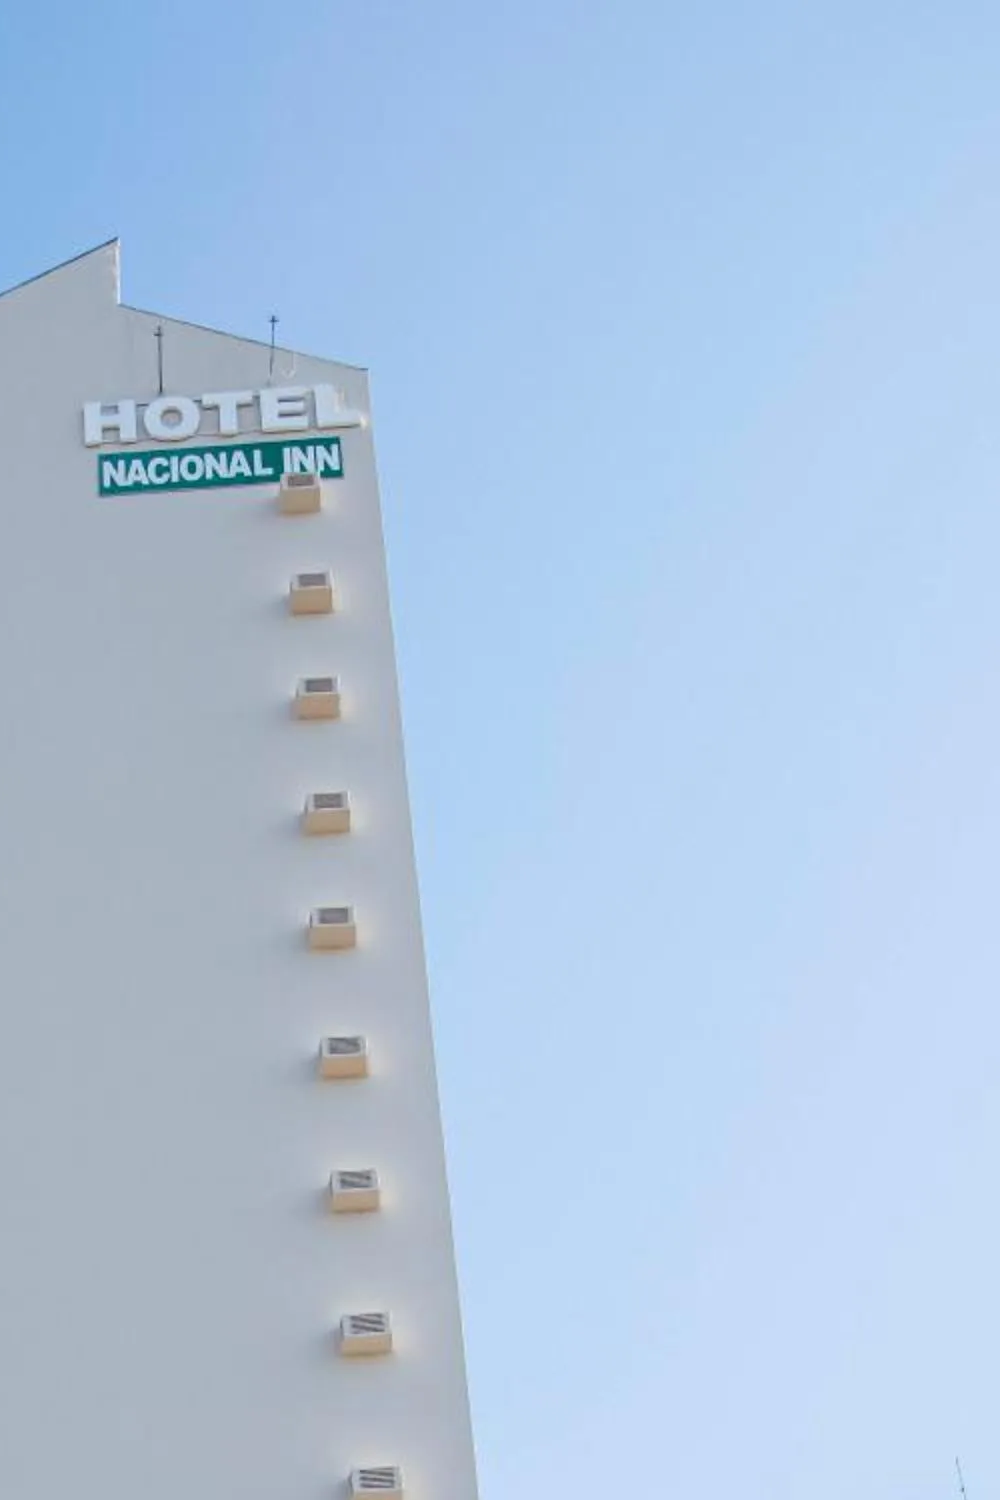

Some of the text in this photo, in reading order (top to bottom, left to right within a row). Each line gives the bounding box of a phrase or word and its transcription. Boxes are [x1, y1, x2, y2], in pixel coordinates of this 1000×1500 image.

[83, 384, 362, 446] HOTEL
[102, 444, 340, 488] NACIONAL INN
